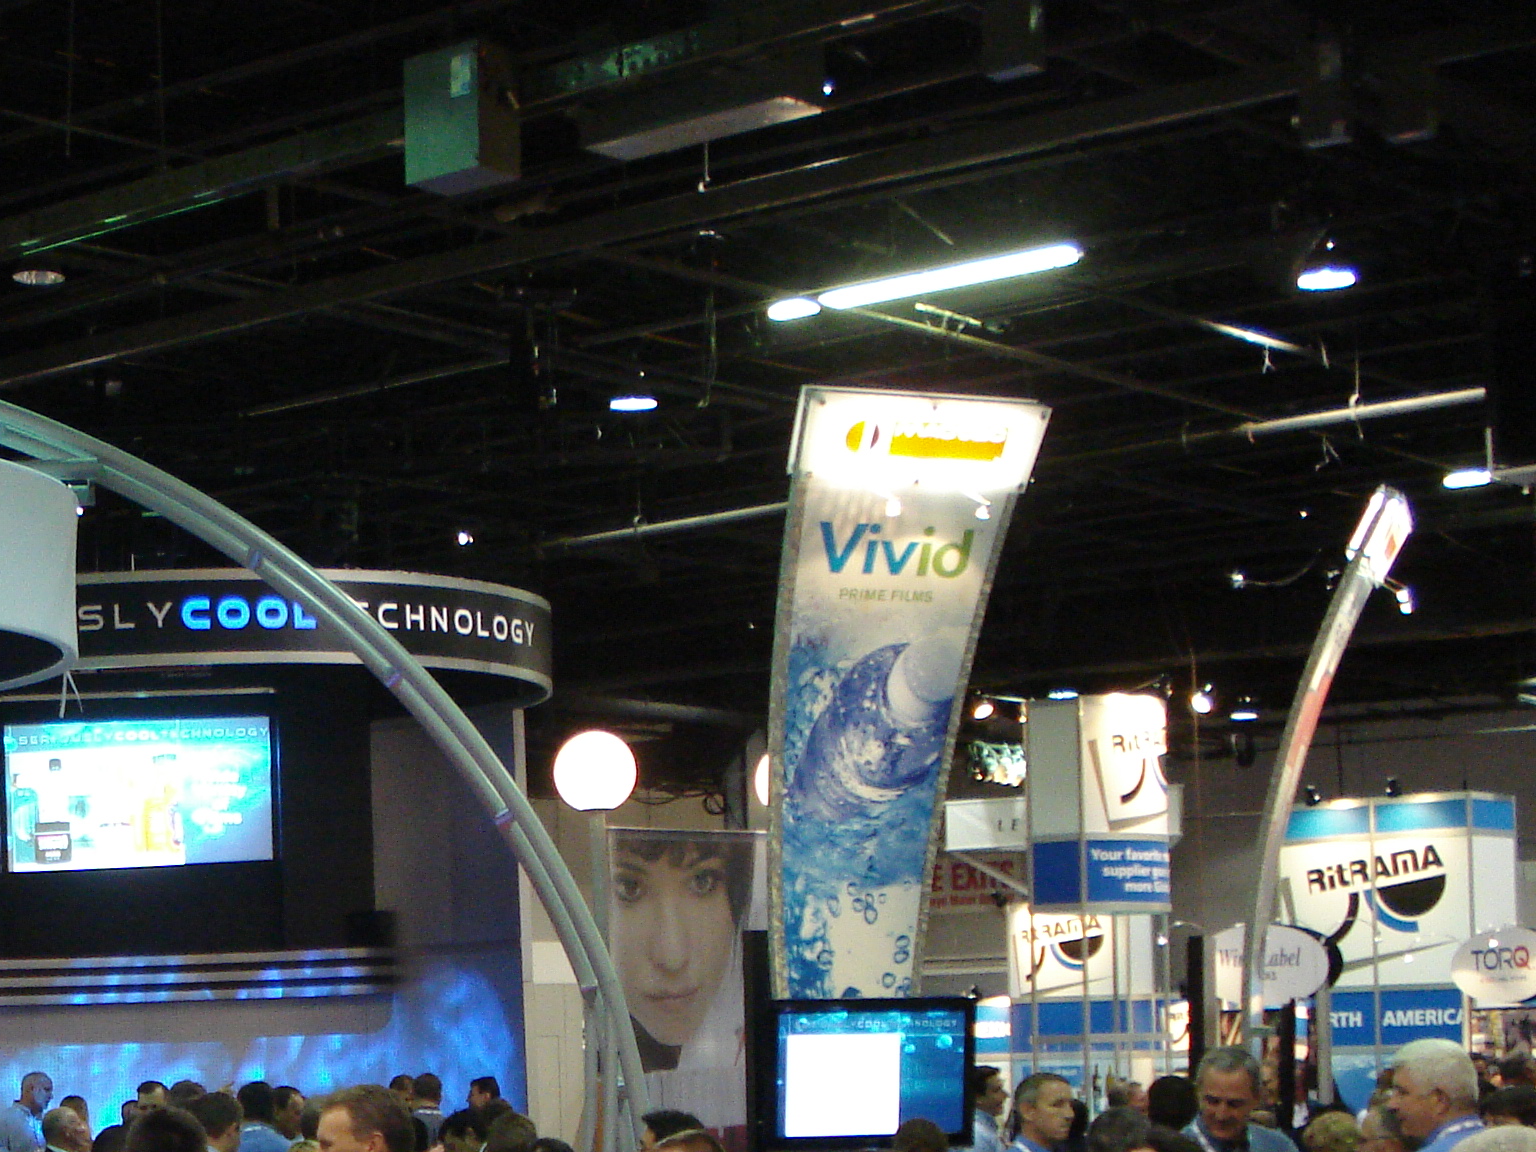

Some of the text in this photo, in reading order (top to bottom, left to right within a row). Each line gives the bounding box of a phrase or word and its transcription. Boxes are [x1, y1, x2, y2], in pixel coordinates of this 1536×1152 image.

[819, 521, 975, 578] Vivid
[839, 587, 933, 603] PRIME FILMS
[1090, 847, 1124, 861] Your
[1470, 946, 1532, 972] TORQ
[1330, 1011, 1363, 1028] RTH
